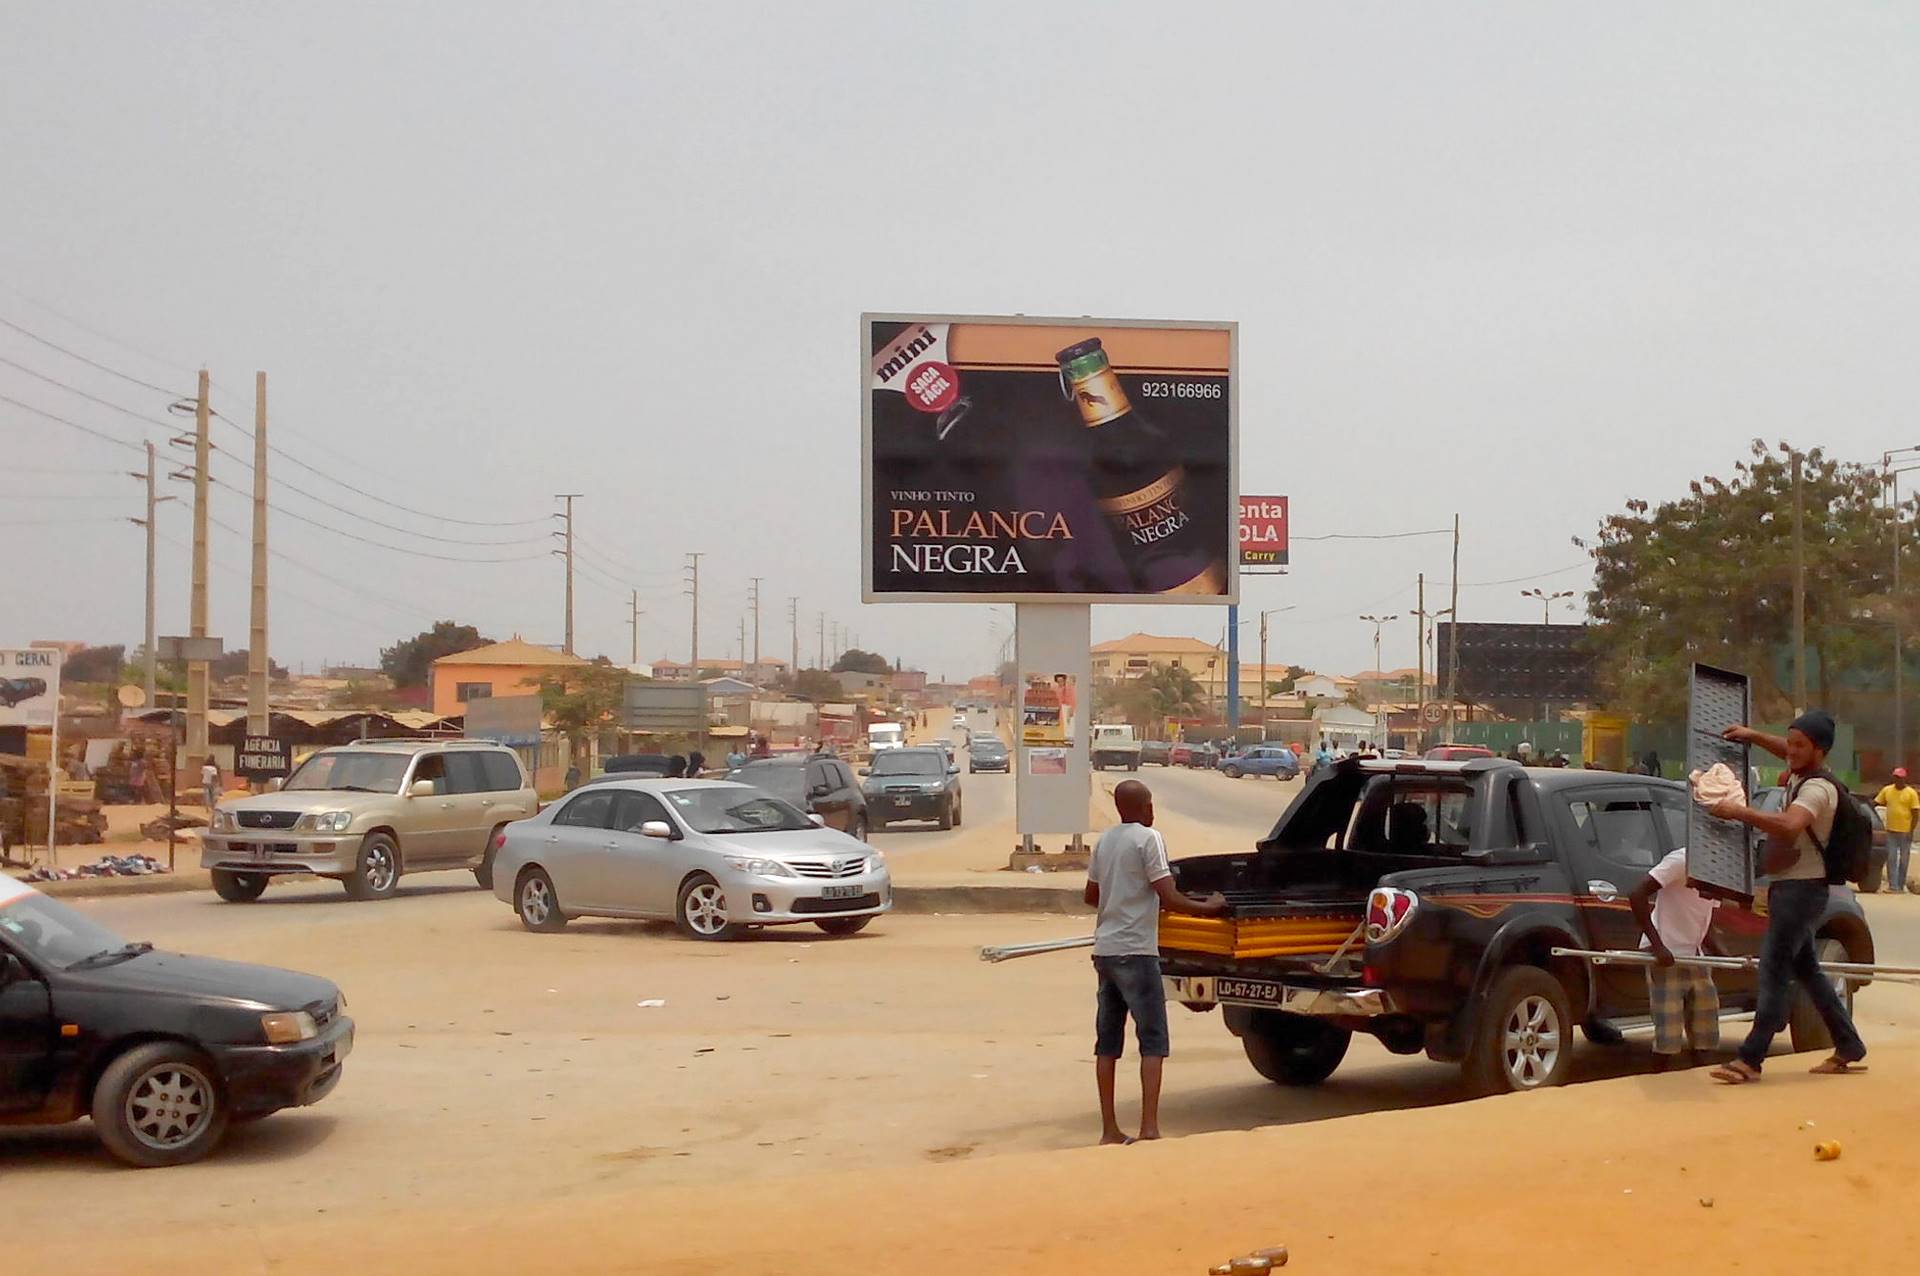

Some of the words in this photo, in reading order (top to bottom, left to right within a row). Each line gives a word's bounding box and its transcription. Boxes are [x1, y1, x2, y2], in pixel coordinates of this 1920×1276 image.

[876, 326, 937, 383] mini
[910, 366, 940, 394] SACA
[1142, 382, 1222, 398] 923166966
[890, 490, 932, 501] VINHO
[934, 490, 975, 502] TINTO
[890, 508, 1075, 540] PALANCA
[1130, 511, 1190, 545] NEGRA
[890, 544, 1028, 574] NEGRA
[1244, 550, 1276, 561] Carry
[15, 652, 53, 666] GERAL
